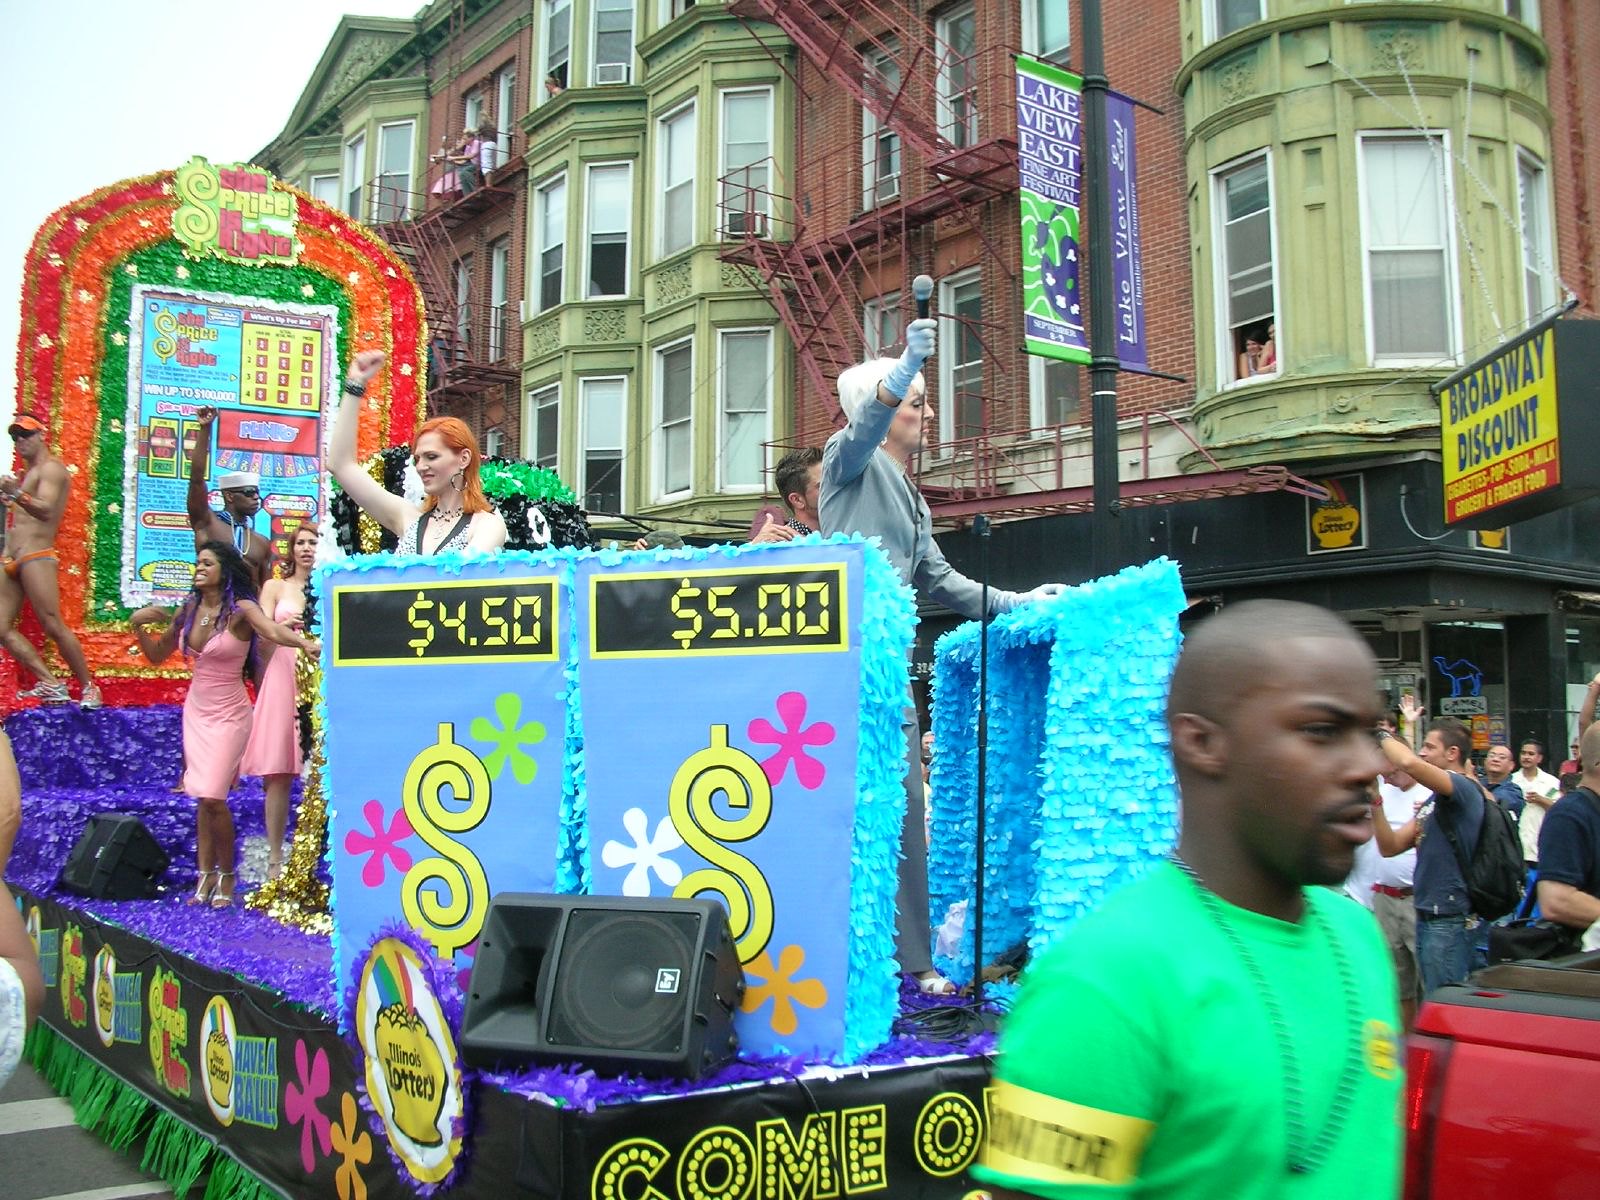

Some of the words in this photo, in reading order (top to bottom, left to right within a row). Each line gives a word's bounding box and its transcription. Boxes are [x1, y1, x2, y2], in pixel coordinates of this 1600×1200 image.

[1019, 76, 1079, 117] LAKE
[1020, 103, 1077, 141] VIEW
[1020, 131, 1080, 170] EAST
[1111, 119, 1125, 171] East
[1023, 158, 1049, 180] FINE
[1051, 170, 1077, 187] ART
[1023, 175, 1078, 205] FESTIVAL
[1115, 188, 1129, 259] View
[1032, 319, 1078, 338] SEPTEMBER
[1119, 280, 1134, 344] Lake
[143, 383, 164, 395] WIN
[164, 386, 179, 398] UP
[180, 387, 194, 399] TO
[1449, 333, 1546, 426] BROADWAY
[239, 421, 299, 443] PLINKO
[1457, 394, 1539, 472] DISCOUNT
[407, 590, 542, 657] $4.50
[671, 577, 830, 650] $5.00
[235, 1039, 266, 1076] HAVE
[266, 1041, 278, 1076] A
[388, 1042, 422, 1068] Illinois
[592, 1103, 888, 1200] COME
